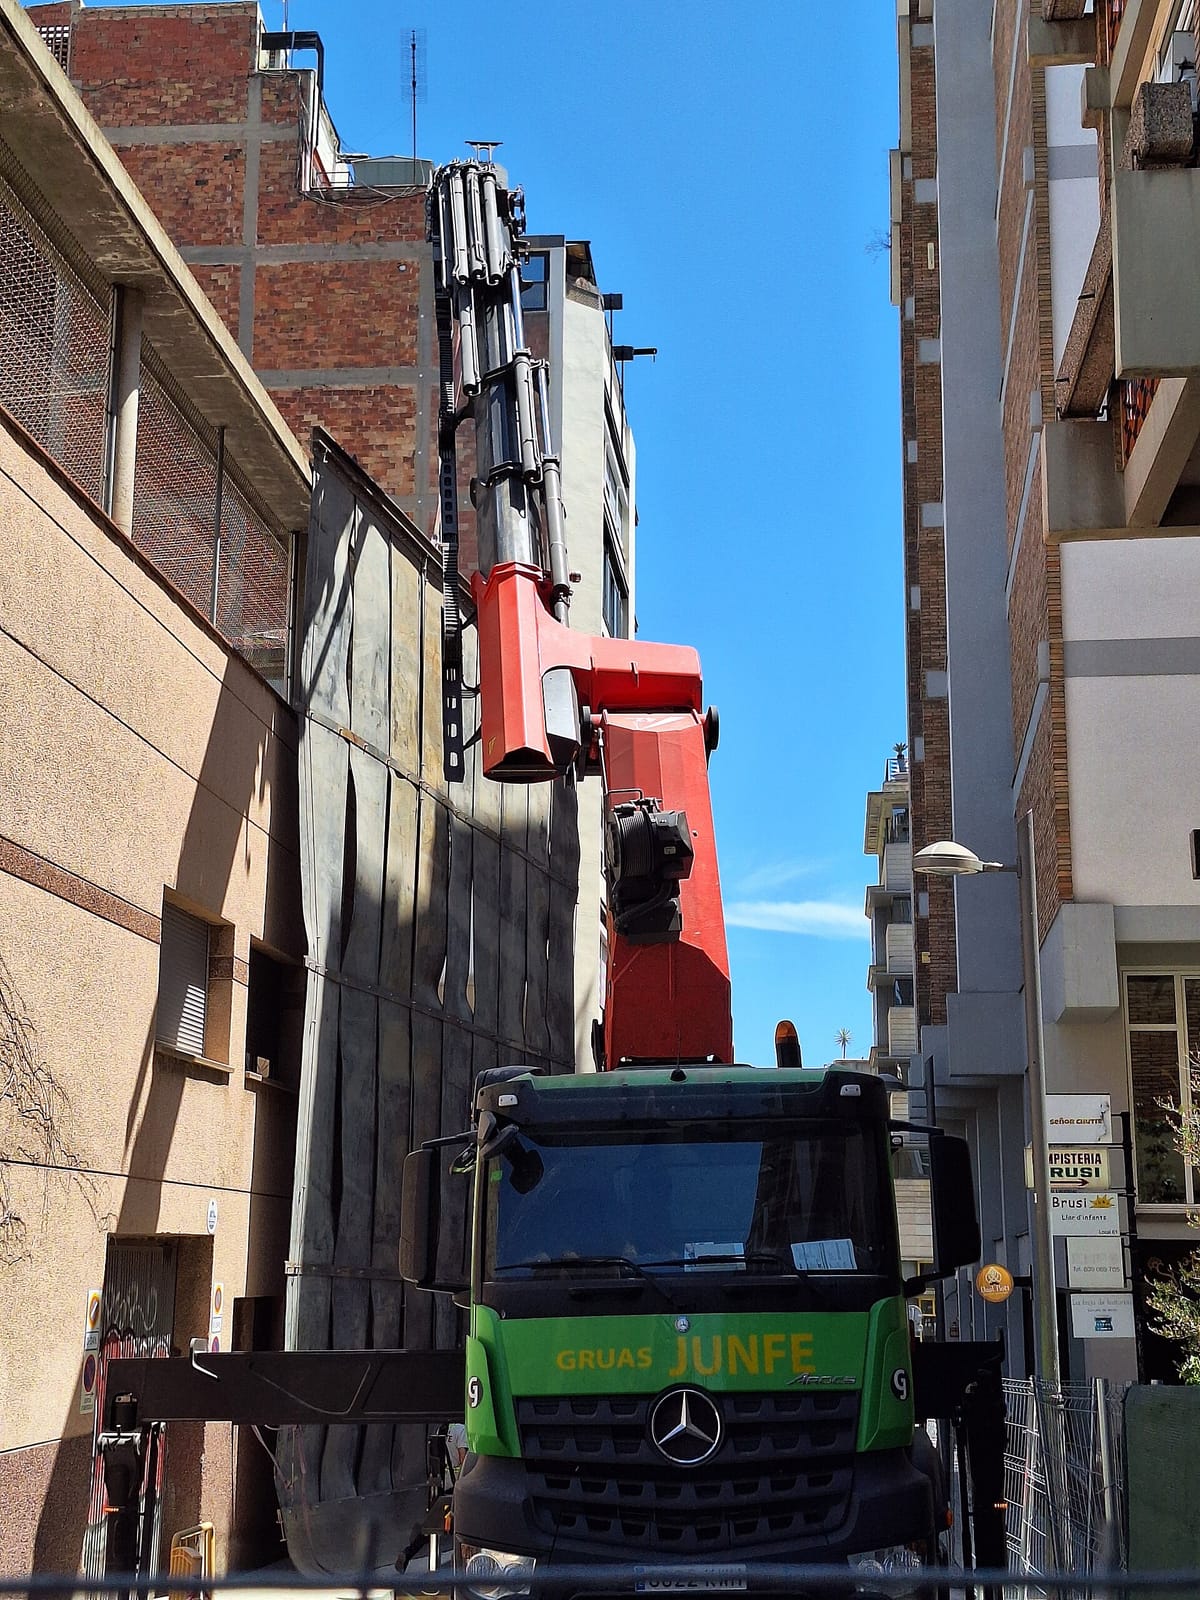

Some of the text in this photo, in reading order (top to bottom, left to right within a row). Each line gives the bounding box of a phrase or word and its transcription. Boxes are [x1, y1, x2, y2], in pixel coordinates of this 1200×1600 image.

[1052, 1196, 1087, 1209] Brusi
[556, 1333, 816, 1377] GRUAS JUNFE
